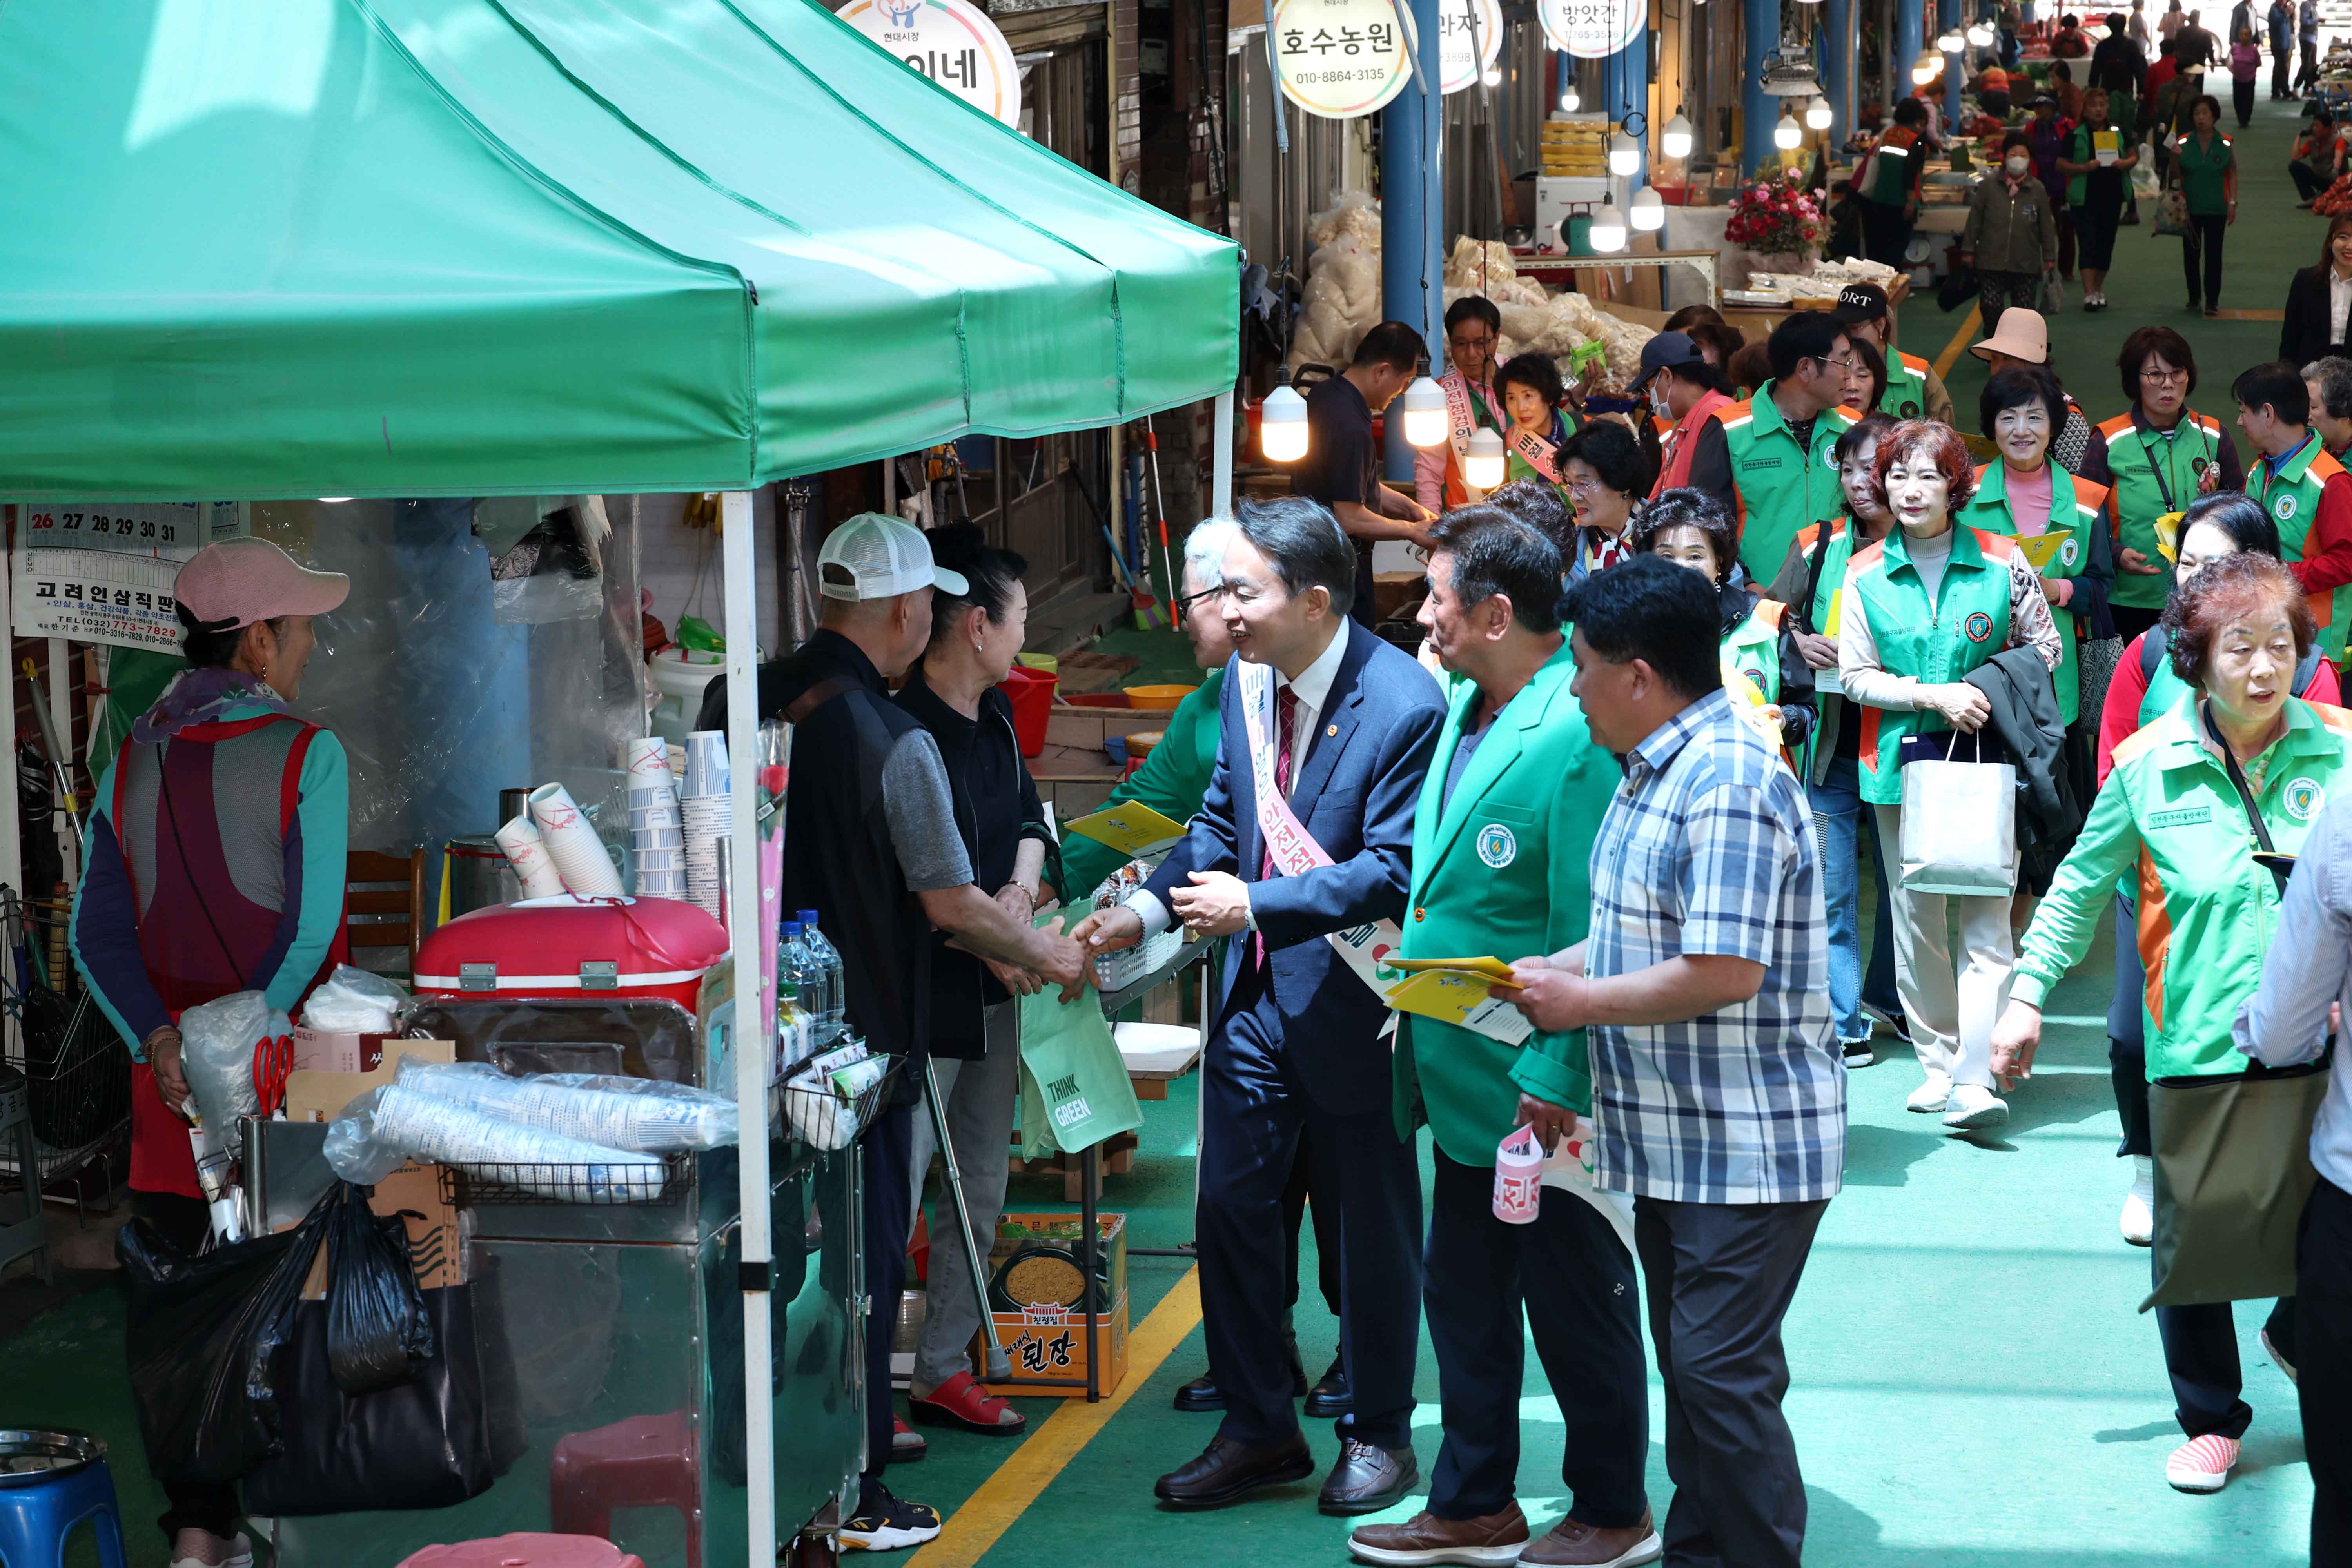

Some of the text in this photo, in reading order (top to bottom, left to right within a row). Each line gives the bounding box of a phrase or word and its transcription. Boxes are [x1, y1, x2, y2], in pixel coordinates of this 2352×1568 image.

[1563, 5, 1618, 25] 방앗간
[884, 32, 920, 42] 현대시장
[1282, 23, 1392, 55] 호수농원
[1296, 68, 1384, 84] 010-8864-3135
[1840, 292, 1871, 307] ORT
[1518, 433, 1545, 459] 매월
[32, 513, 174, 541] 26 27 28 29 30 31
[114, 621, 176, 637] 773-7829
[1047, 1074, 1080, 1102] THINK
[1054, 1097, 1092, 1127] GREEN
[1033, 1316, 1057, 1325] 친정집
[1022, 1330, 1077, 1372] 된장
